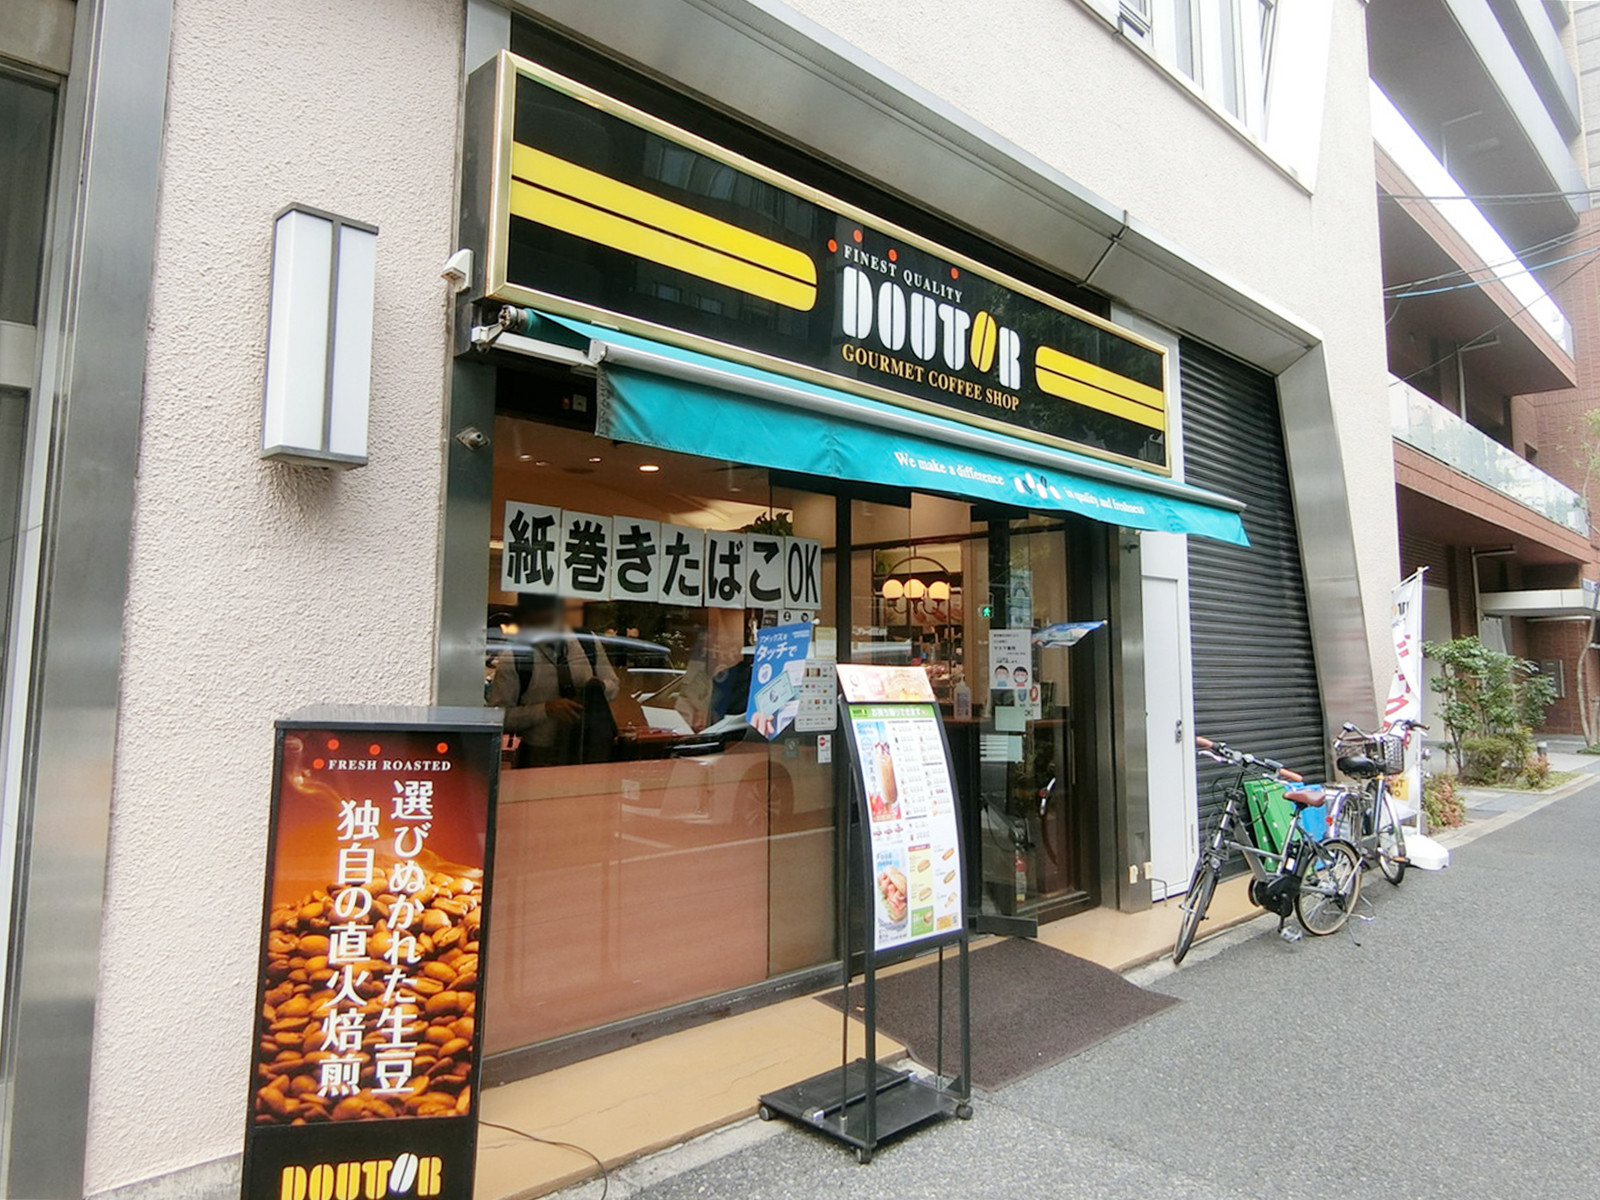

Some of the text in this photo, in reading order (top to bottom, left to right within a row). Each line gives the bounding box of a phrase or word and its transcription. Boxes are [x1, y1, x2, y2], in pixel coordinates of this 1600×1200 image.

[844, 245, 963, 303] FINEST QUALITY
[842, 266, 1021, 391] DOUTOR
[842, 343, 1020, 412] GOURMET COFFEE SHOP
[894, 451, 1005, 485] We make a difference
[508, 509, 819, 603] 紙巻きたばこOK
[757, 642, 797, 662] タッチで
[328, 759, 451, 772] FRESH ROASTED
[317, 800, 380, 1097] 独自の直火焙煎
[371, 780, 434, 1094] 選びぬかれた生豆
[281, 1153, 443, 1200] DOUTOR
